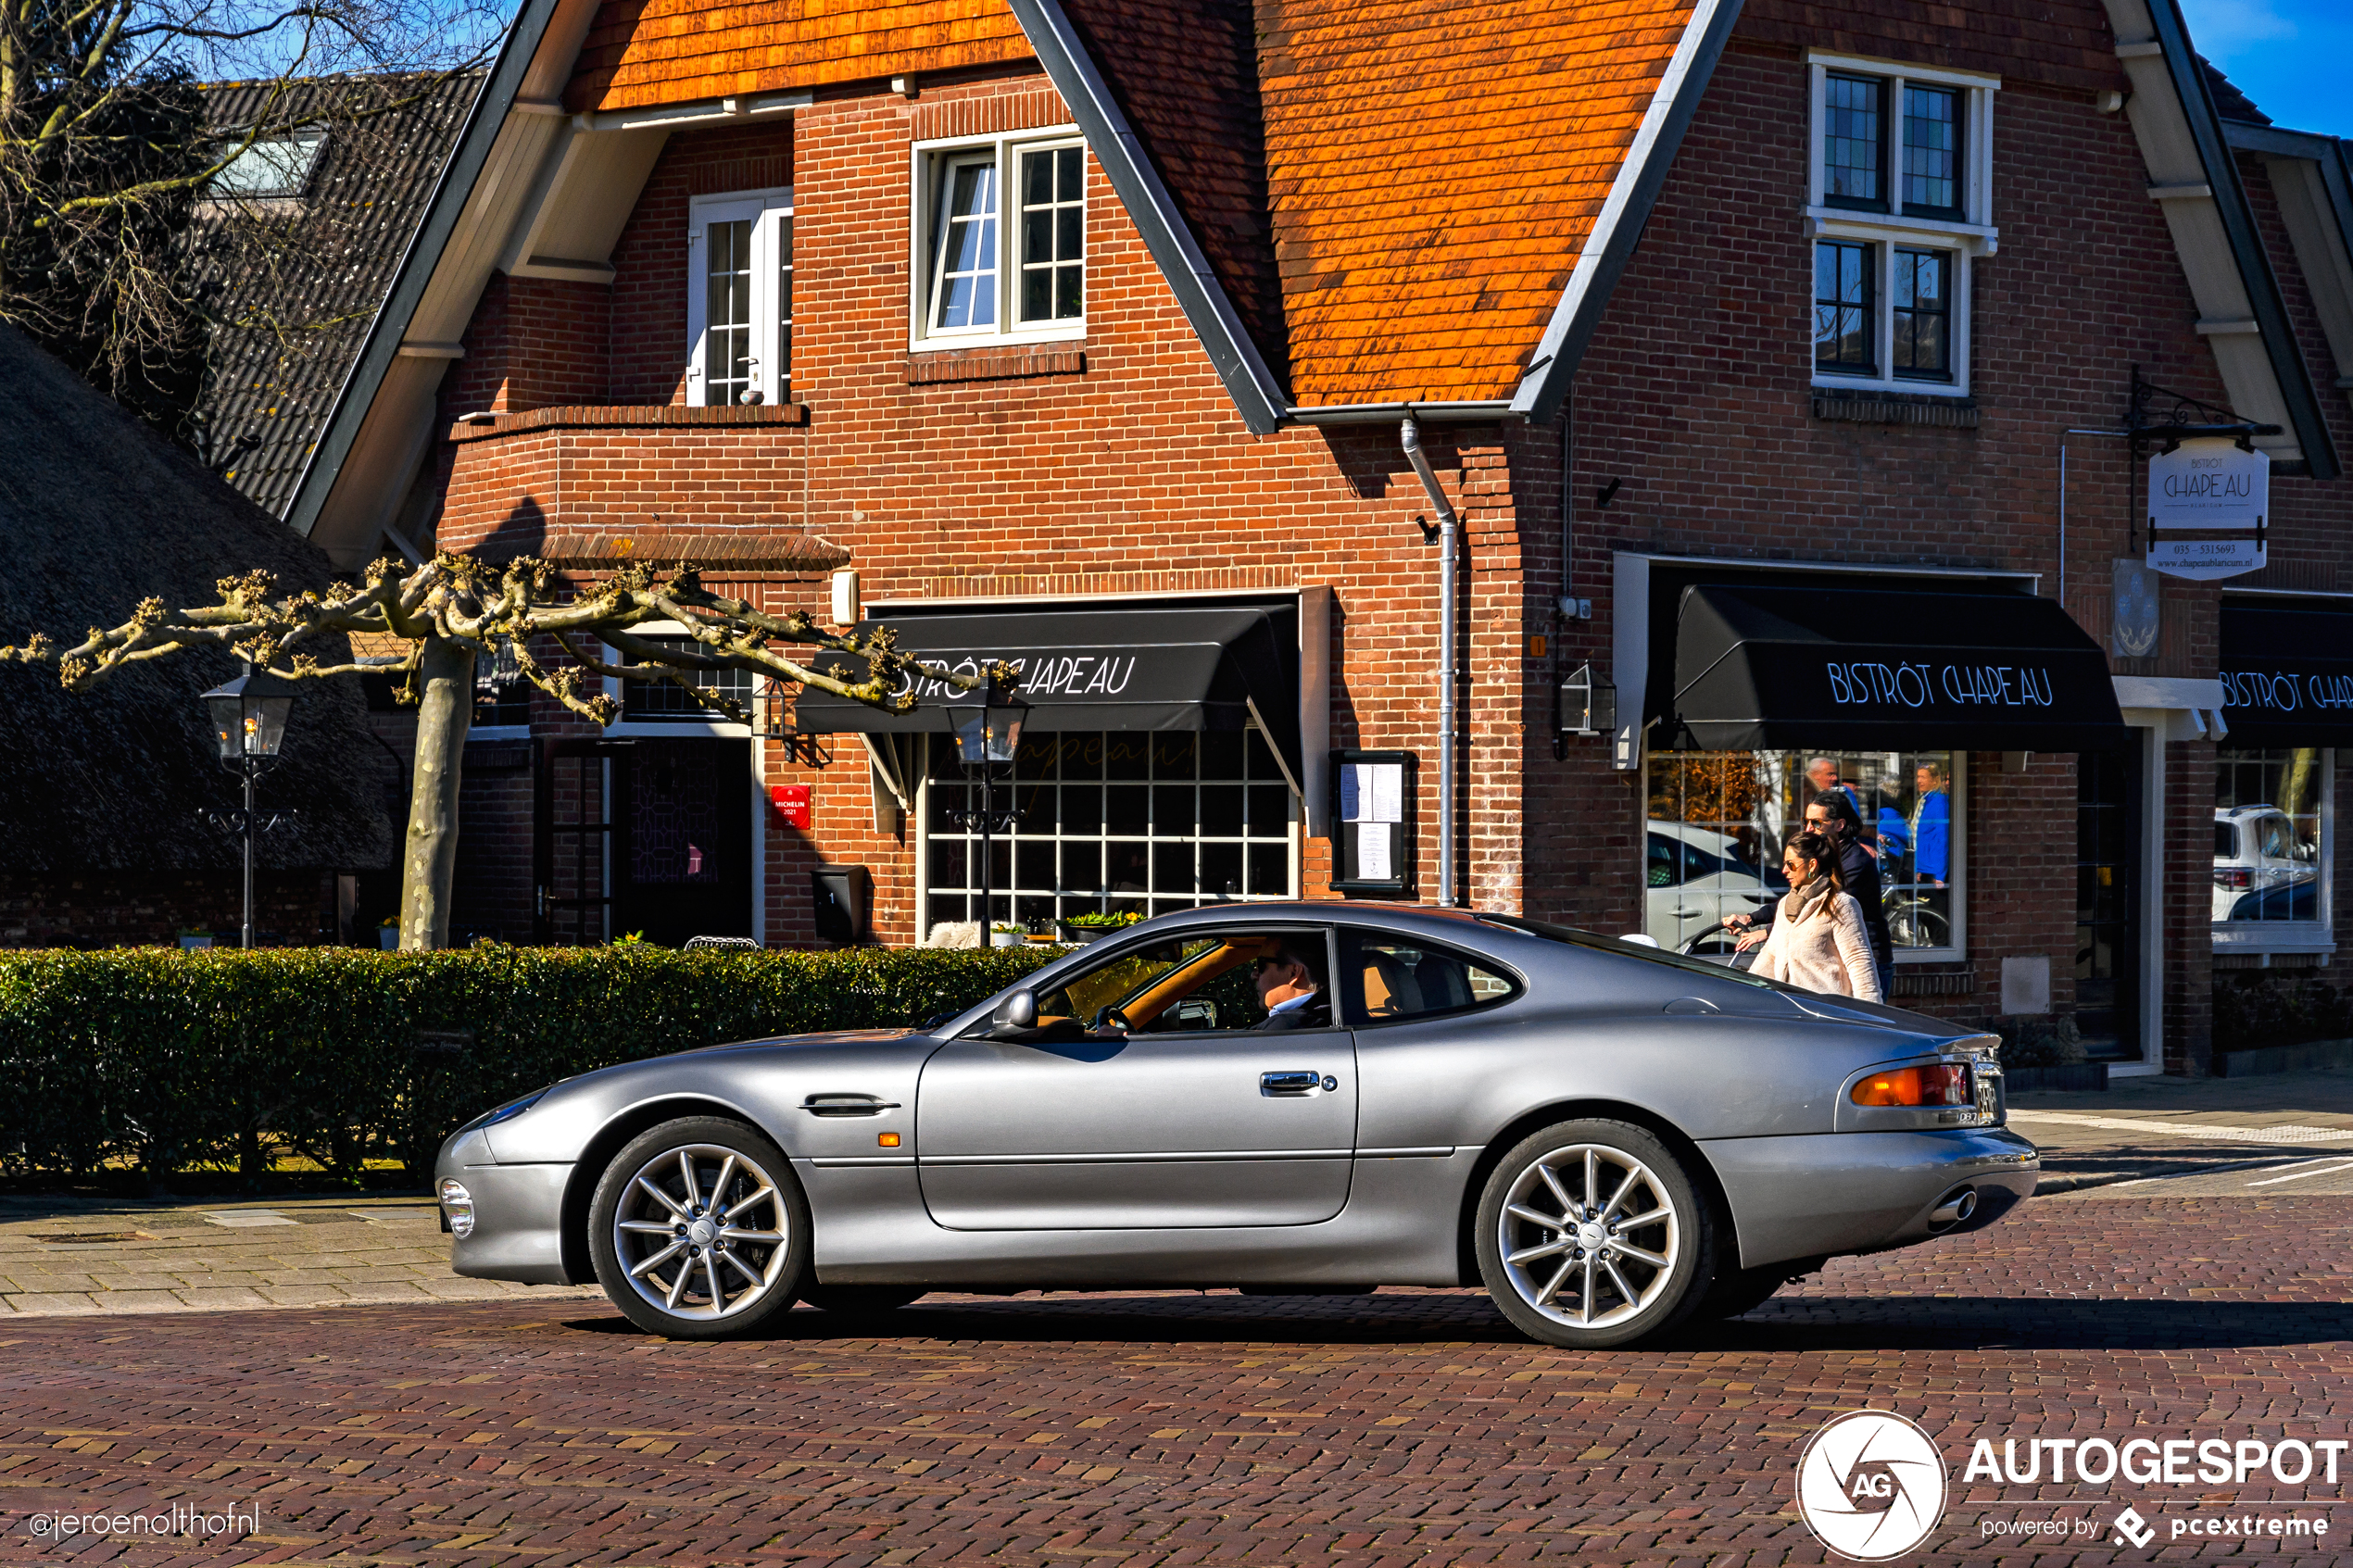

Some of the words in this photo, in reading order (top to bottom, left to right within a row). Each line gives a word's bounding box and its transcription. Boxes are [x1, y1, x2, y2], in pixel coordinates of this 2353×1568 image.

[2164, 473, 2251, 498] CHAPEAU
[2174, 545, 2190, 554] 035
[2200, 545, 2236, 555] 5315693
[2158, 558, 2253, 570] www.chapeaublaricum.nl
[1010, 656, 1137, 696] HAPEAU
[1827, 660, 1934, 708] BISTRÔT
[1943, 665, 2053, 706] CHAPEAU
[2219, 671, 2304, 711] BISTRÔT
[829, 892, 835, 904] 1
[1959, 1112, 1978, 1122] DB7
